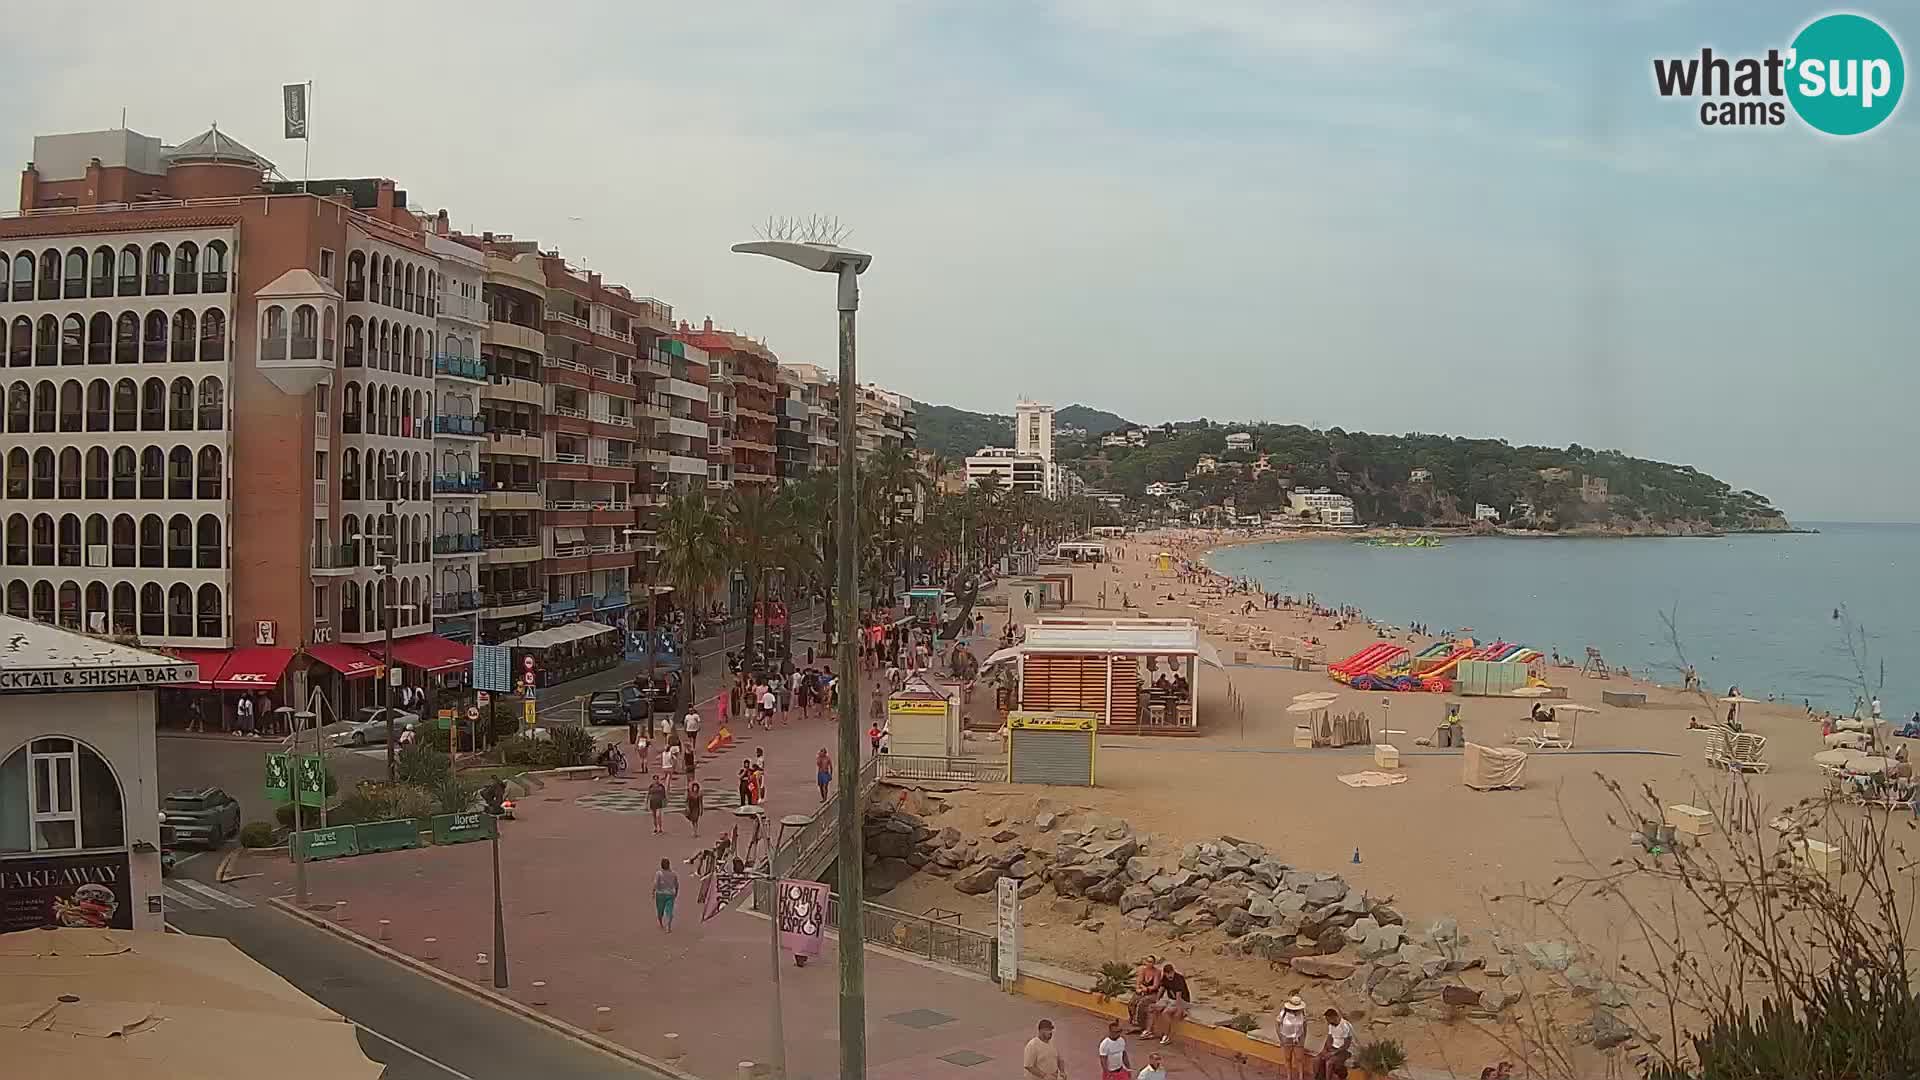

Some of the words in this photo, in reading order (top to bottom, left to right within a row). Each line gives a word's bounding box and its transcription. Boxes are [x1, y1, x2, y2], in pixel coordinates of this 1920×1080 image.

[314, 627, 332, 643] KFC
[0, 671, 59, 687] CKTAIL
[63, 671, 74, 685] &
[79, 669, 140, 685] SHISHA
[144, 667, 178, 682] BAR
[229, 673, 267, 681] KFC
[0, 864, 120, 889] TAKEAWAY
